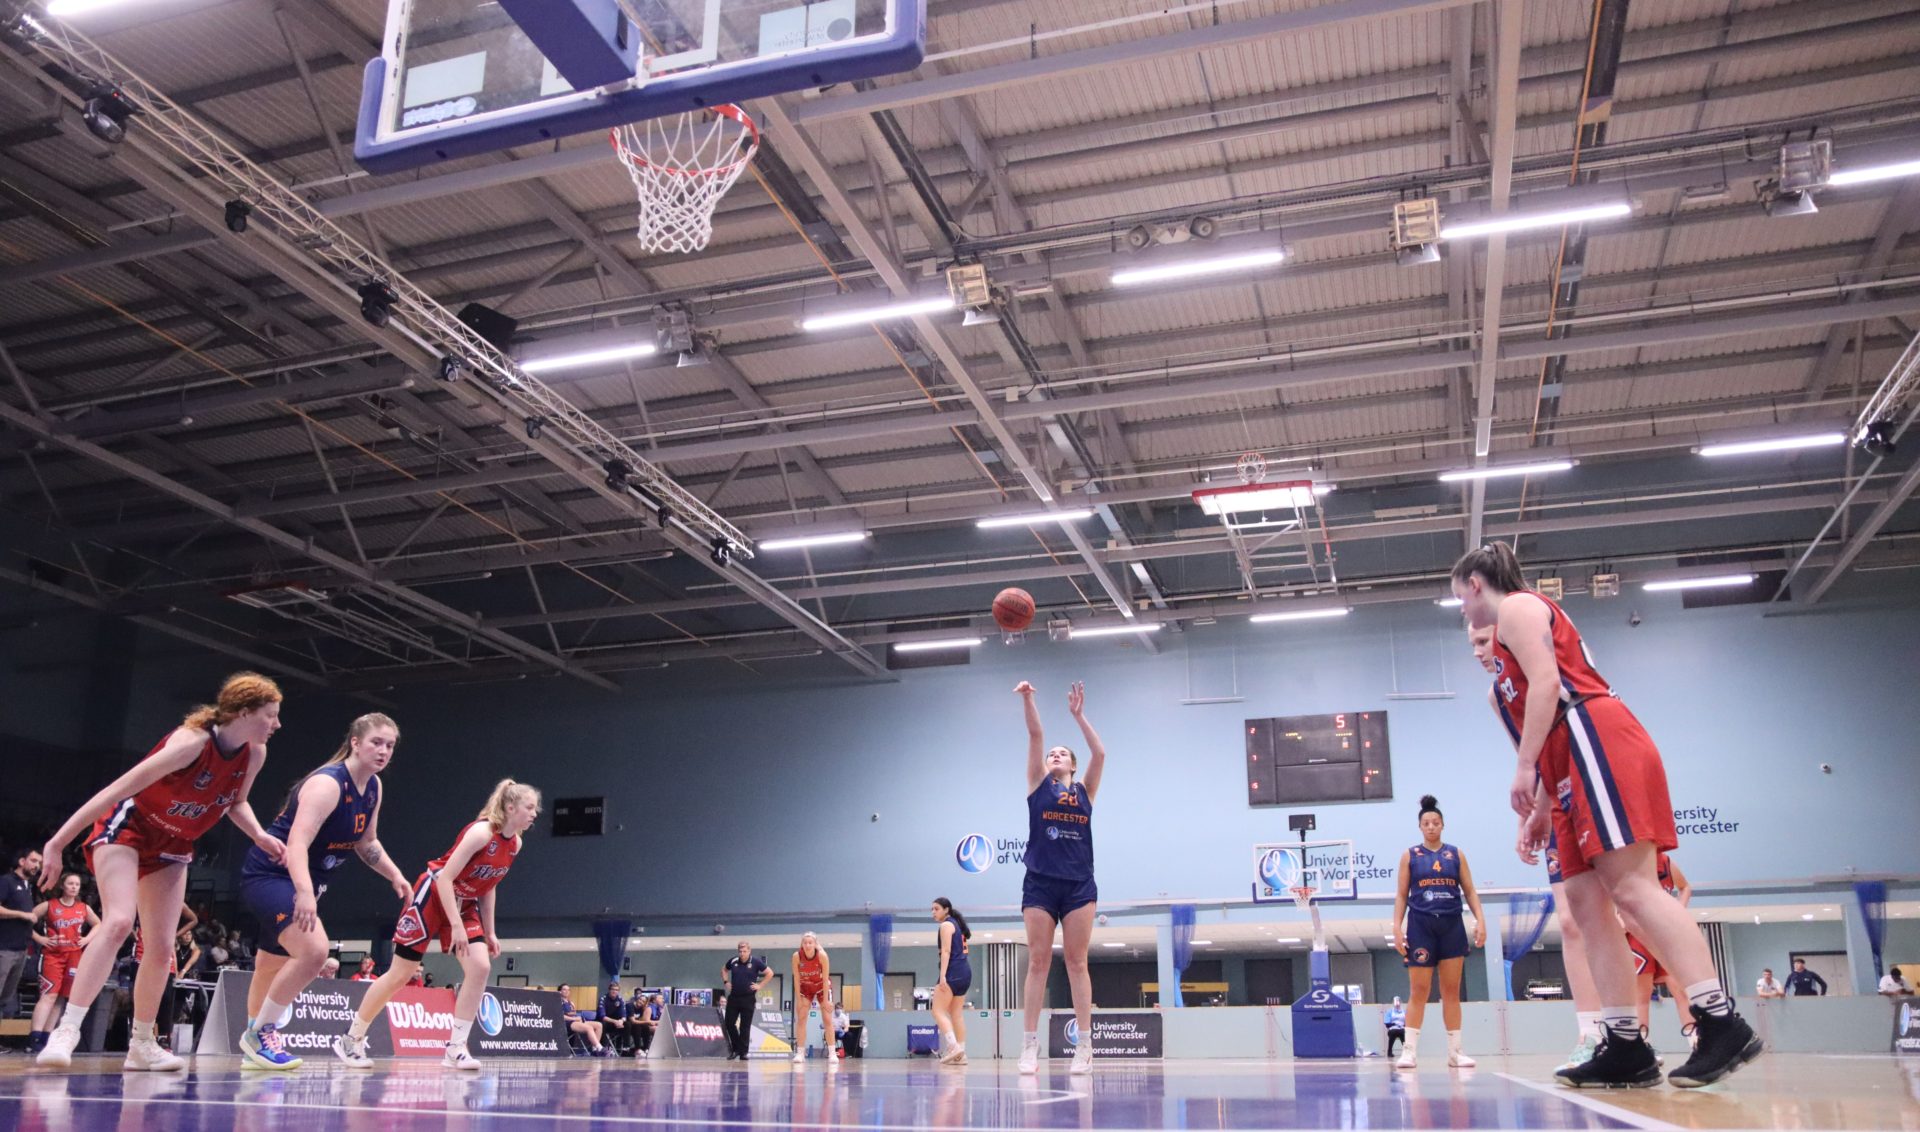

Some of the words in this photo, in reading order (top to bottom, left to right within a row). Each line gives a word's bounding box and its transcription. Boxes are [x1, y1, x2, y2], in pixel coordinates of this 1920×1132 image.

[1500, 677, 1518, 702] 32
[1335, 714, 1345, 728] 5
[1042, 810, 1088, 825] WORCESTER
[1674, 806, 1717, 822] ersity
[150, 812, 182, 833] Morgan
[354, 813, 367, 833] 13
[1675, 821, 1740, 835] orcester
[997, 852, 1009, 865] of
[1432, 860, 1442, 872] 4
[295, 1005, 308, 1019] of
[308, 1006, 356, 1020] Worcest
[386, 1001, 454, 1030] Wilson
[502, 1000, 542, 1017] University
[504, 1014, 514, 1027] of
[514, 1015, 553, 1029] Worcester
[1092, 1021, 1136, 1032] University
[687, 1021, 724, 1041] Kappa
[911, 1027, 934, 1035] molten
[1092, 1031, 1102, 1040] of
[1103, 1031, 1148, 1040] Worcester
[480, 1040, 558, 1051] www.worcester.ac.uk
